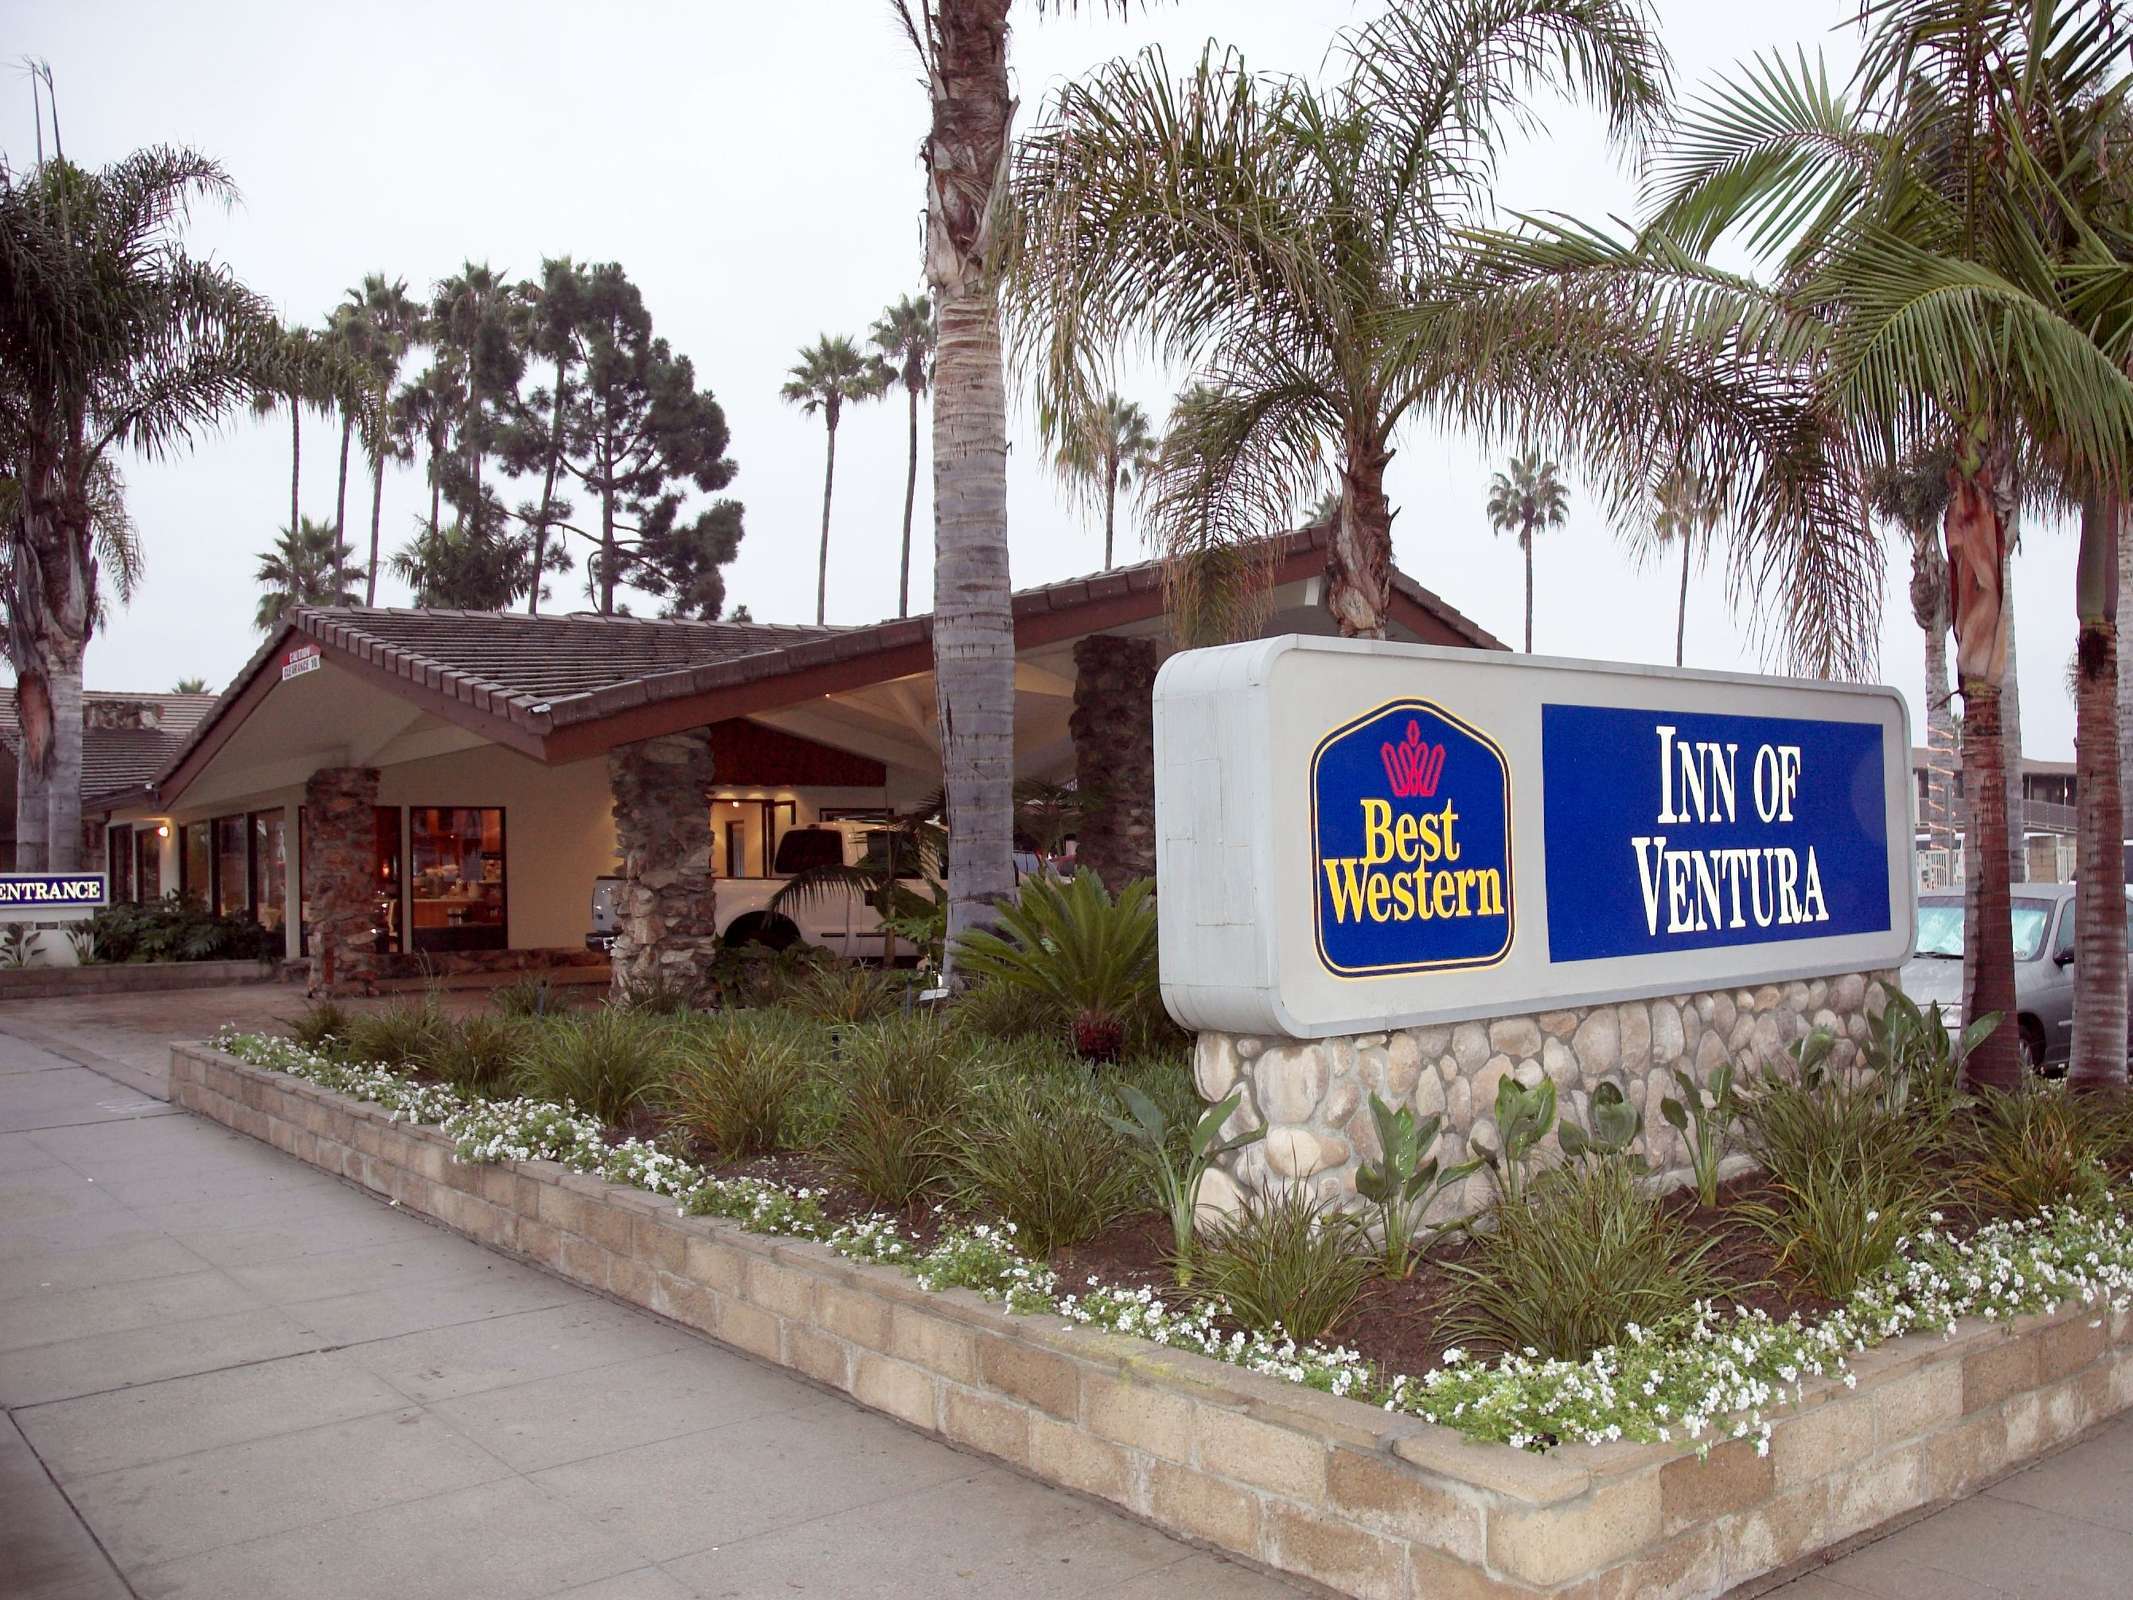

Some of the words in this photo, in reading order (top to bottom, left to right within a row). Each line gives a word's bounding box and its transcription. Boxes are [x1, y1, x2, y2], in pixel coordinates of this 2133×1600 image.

[1656, 726, 1738, 823] INN
[1753, 743, 1801, 823] OF
[1360, 798, 1460, 864] Best
[1322, 855, 1505, 924] Western
[1631, 836, 1830, 936] VENTURA
